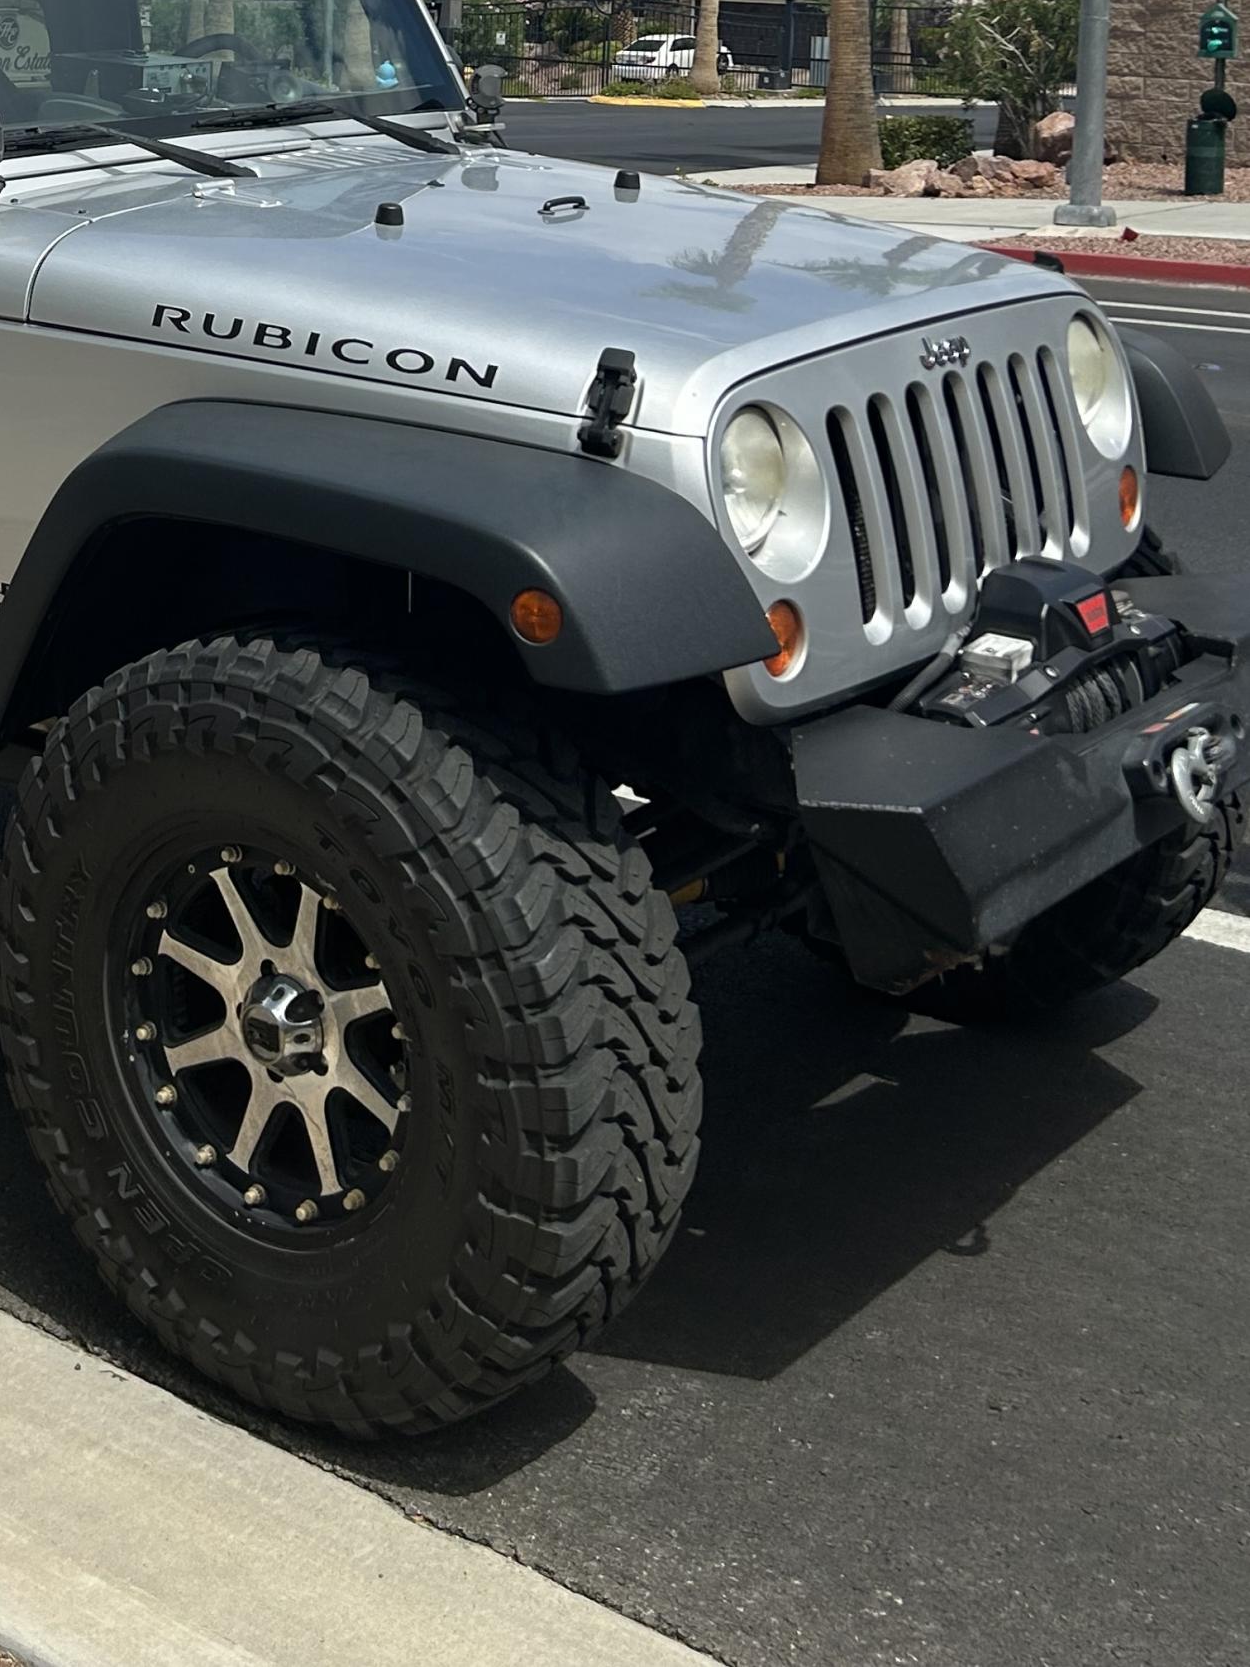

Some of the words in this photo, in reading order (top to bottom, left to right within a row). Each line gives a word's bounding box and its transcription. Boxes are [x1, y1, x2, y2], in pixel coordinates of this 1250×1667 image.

[151, 303, 499, 389] RUBICON
[919, 335, 971, 371] Jeep
[312, 821, 437, 1011] TOYO
[104, 1160, 234, 1282] OPEN
